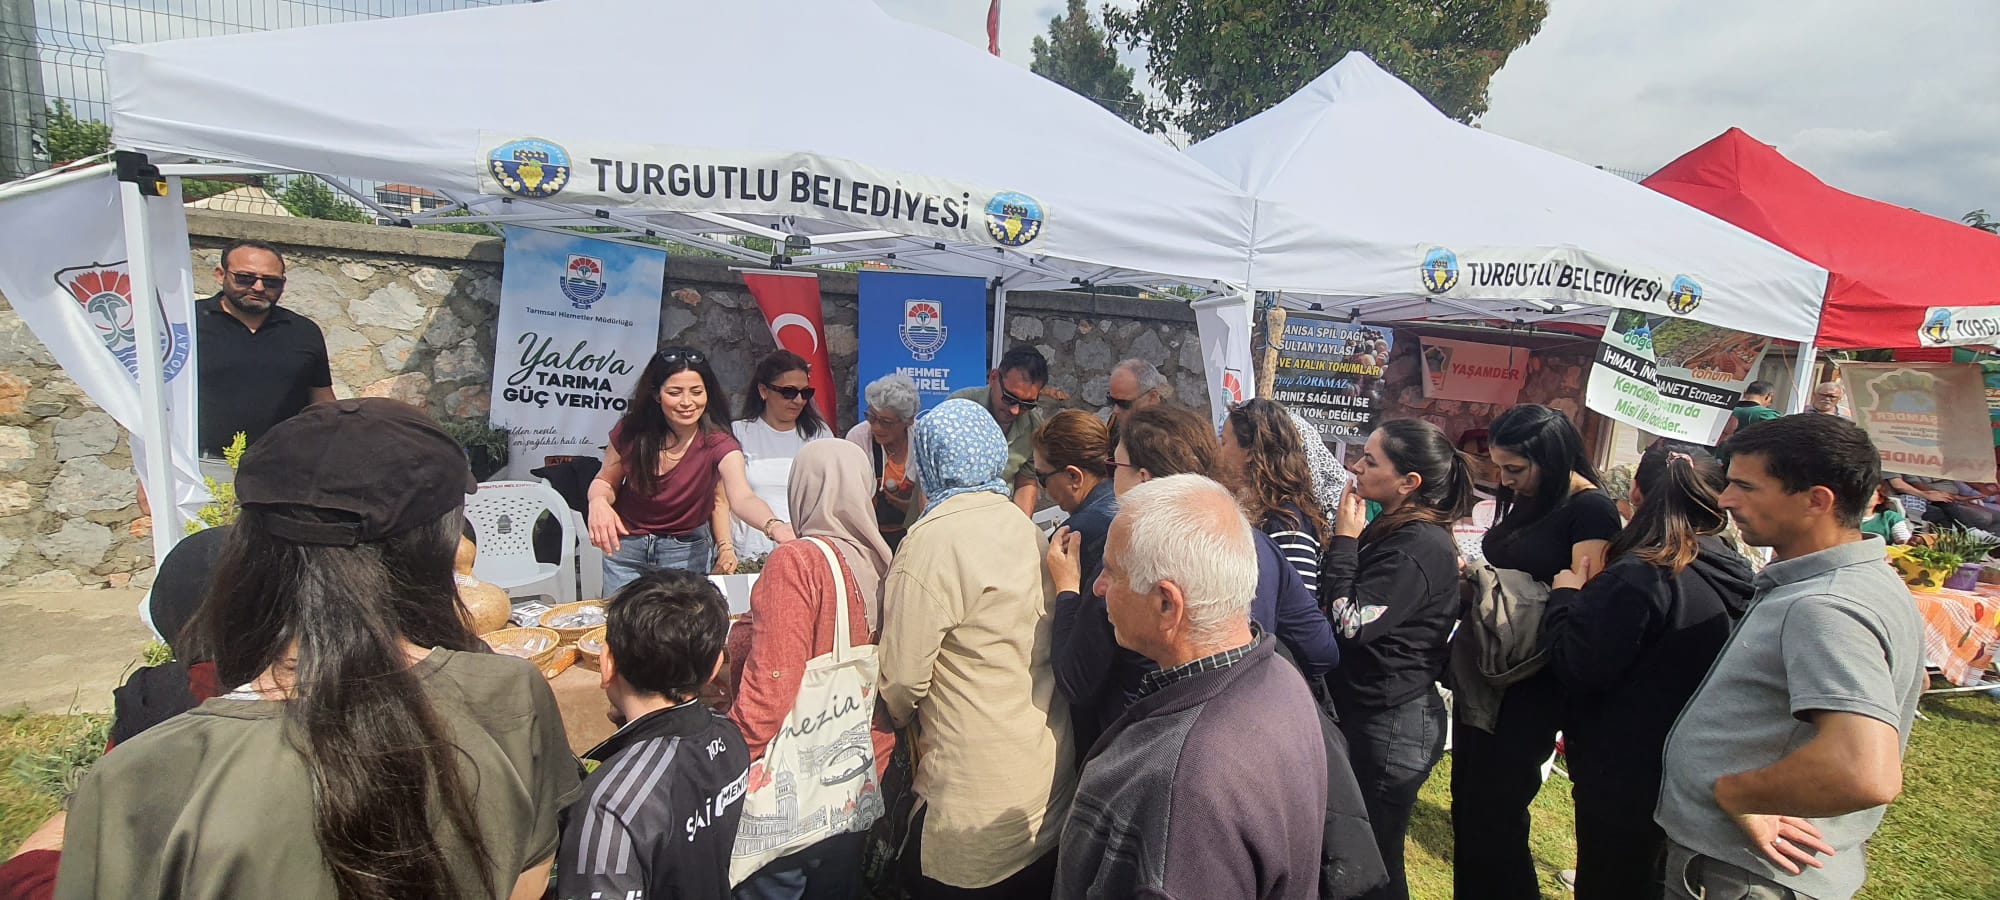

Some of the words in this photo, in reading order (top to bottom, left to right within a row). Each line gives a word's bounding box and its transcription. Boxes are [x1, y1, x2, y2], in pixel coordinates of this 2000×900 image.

[590, 157, 779, 202] TURGUTLU
[790, 171, 970, 230] BELEDİYESİ
[1467, 261, 1556, 287] TURGUTLU
[1557, 264, 1662, 302] BELEDİYESİ
[526, 306, 557, 317] Tarımsal
[559, 311, 593, 322] Hizmetler
[595, 316, 634, 328] Müdürlüğü
[1281, 325, 1314, 338] ANISA
[1278, 340, 1315, 353] SULTAN
[1317, 343, 1355, 356] YAYLASI
[507, 332, 634, 386] Yalova
[1279, 357, 1292, 368] VE
[1294, 358, 1326, 371] ATALIK
[1328, 361, 1381, 376] TOHUMLAR
[896, 366, 950, 379] MEHMET
[1452, 362, 1520, 380] YAŞAMDER
[1691, 366, 1733, 384] tohum
[536, 371, 612, 392] TARIMA
[913, 378, 950, 391] REL
[1296, 375, 1348, 389] KORKMAZ
[503, 386, 549, 408] GÜÇ
[554, 391, 628, 411] VERİYO
[1307, 391, 1351, 405] SAĞLIKLI
[1328, 408, 1370, 422] DEĞİLSE
[779, 694, 860, 739] nezia
